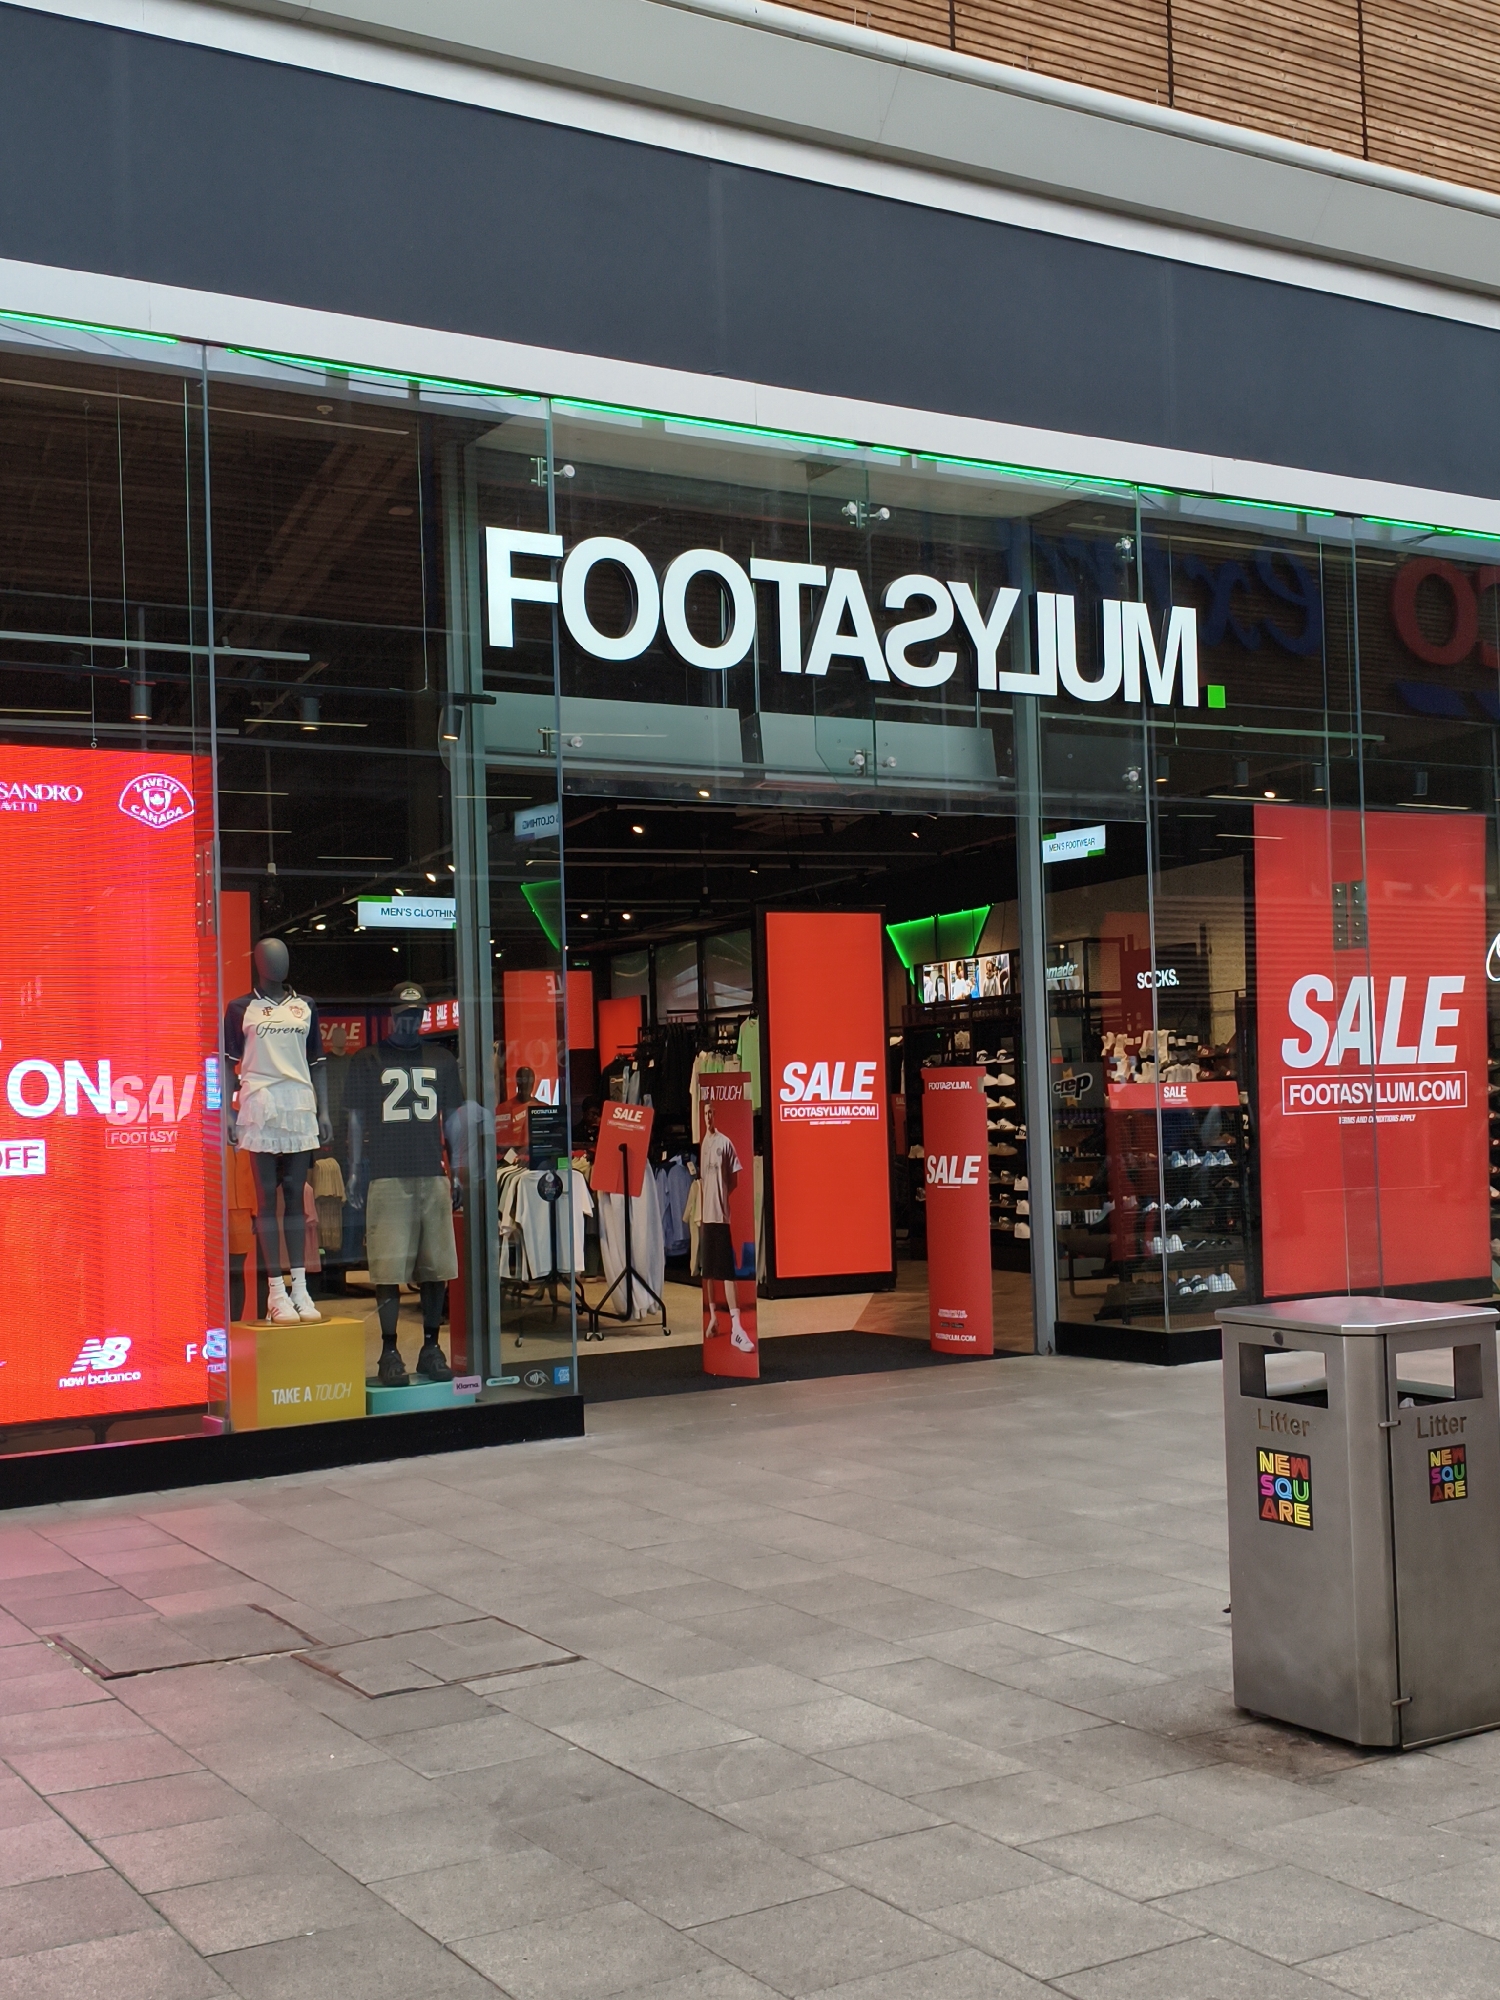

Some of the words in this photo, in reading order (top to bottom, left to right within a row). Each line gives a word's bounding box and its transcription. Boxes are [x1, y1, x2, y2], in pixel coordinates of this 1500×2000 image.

[133, 777, 180, 793] ZAVETTI
[130, 804, 184, 825] CANADA
[1049, 842, 1065, 851] MEN'S
[1066, 837, 1095, 849] FOOTWEAR
[381, 907, 412, 917] MEN'S
[1137, 968, 1179, 989] SOCKS.
[1282, 974, 1465, 1068] SALE
[7, 1059, 128, 1118] ON.
[716, 1085, 742, 1100] TOUCH
[780, 1062, 877, 1102] SALE
[1053, 1074, 1093, 1098] crep
[1164, 1086, 1187, 1098] SALE
[1289, 1080, 1461, 1106] FOOTASYLUM.COM
[381, 1067, 437, 1122] 25
[613, 1107, 643, 1122] SALE
[784, 1106, 875, 1118] FOOTASYLUM.COM
[0, 1146, 39, 1169] FF
[926, 1155, 982, 1184] SALE
[58, 1375, 85, 1388] new
[87, 1370, 142, 1385] balance
[456, 1382, 479, 1390] Klarna
[271, 1387, 301, 1405] TAKE
[303, 1387, 312, 1402] A
[315, 1382, 352, 1401] TOUCH
[1257, 1408, 1310, 1437] Litter
[1416, 1414, 1467, 1439] Litter
[1259, 1450, 1309, 1480] NEW
[1430, 1446, 1465, 1467] NEW
[1431, 1463, 1466, 1484] SQU
[1260, 1474, 1310, 1502] SQU
[1432, 1480, 1467, 1503] ARE
[1261, 1497, 1311, 1527] ARE
